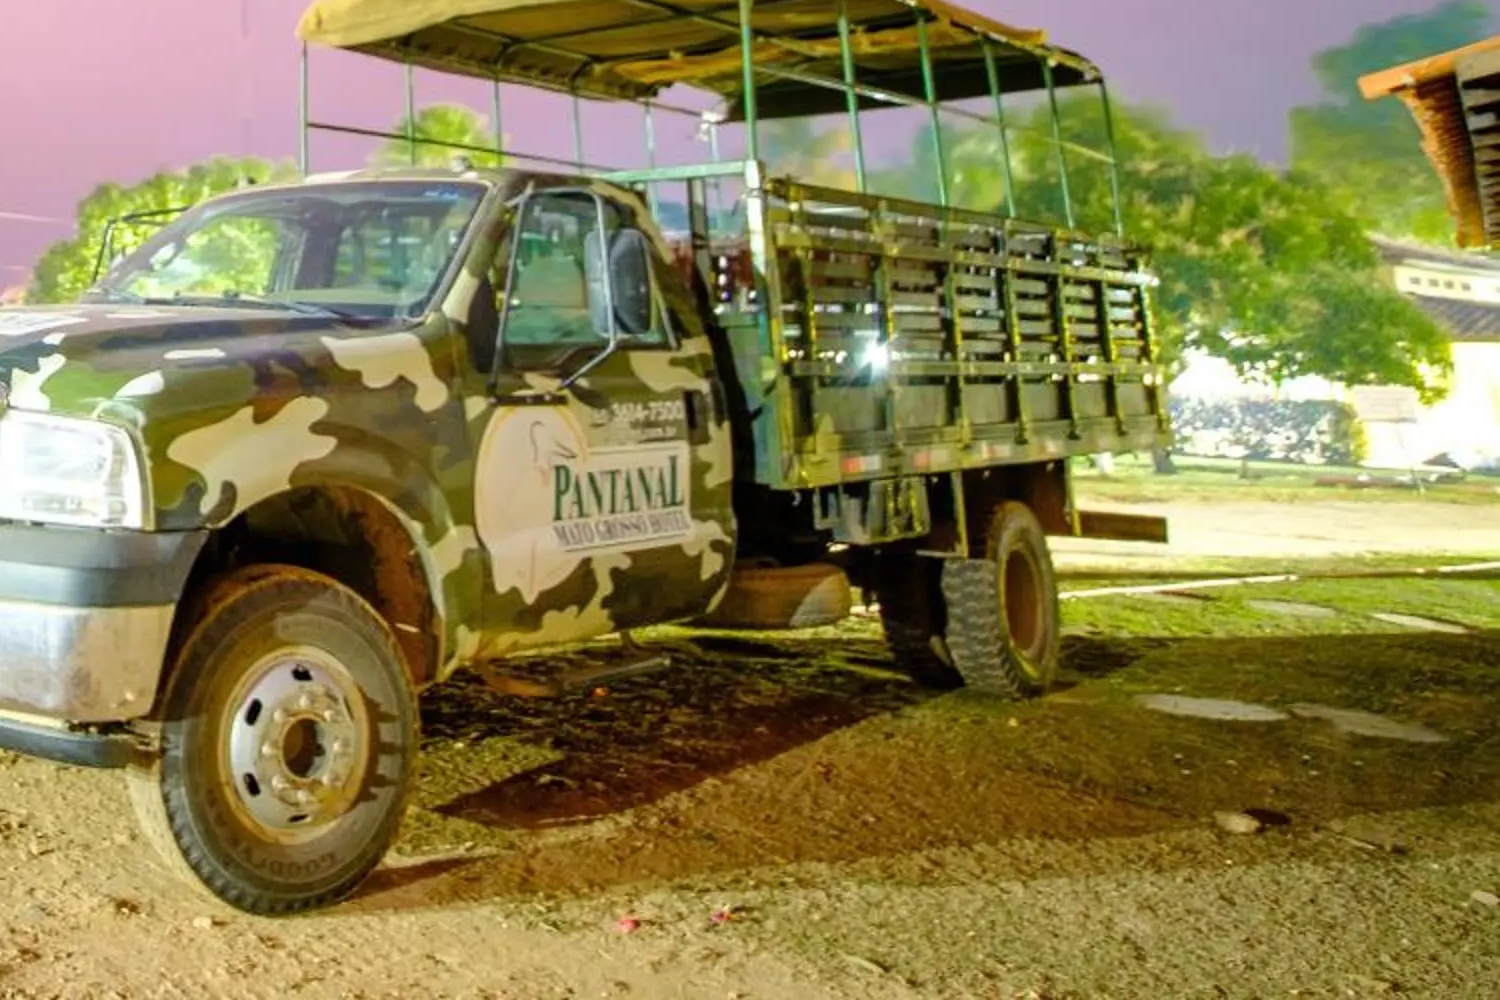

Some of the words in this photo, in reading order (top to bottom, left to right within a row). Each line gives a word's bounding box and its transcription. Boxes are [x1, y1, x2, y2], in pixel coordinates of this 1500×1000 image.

[553, 455, 684, 520] PANTANAL
[554, 521, 594, 546] MATO
[595, 513, 649, 542] GROSSO
